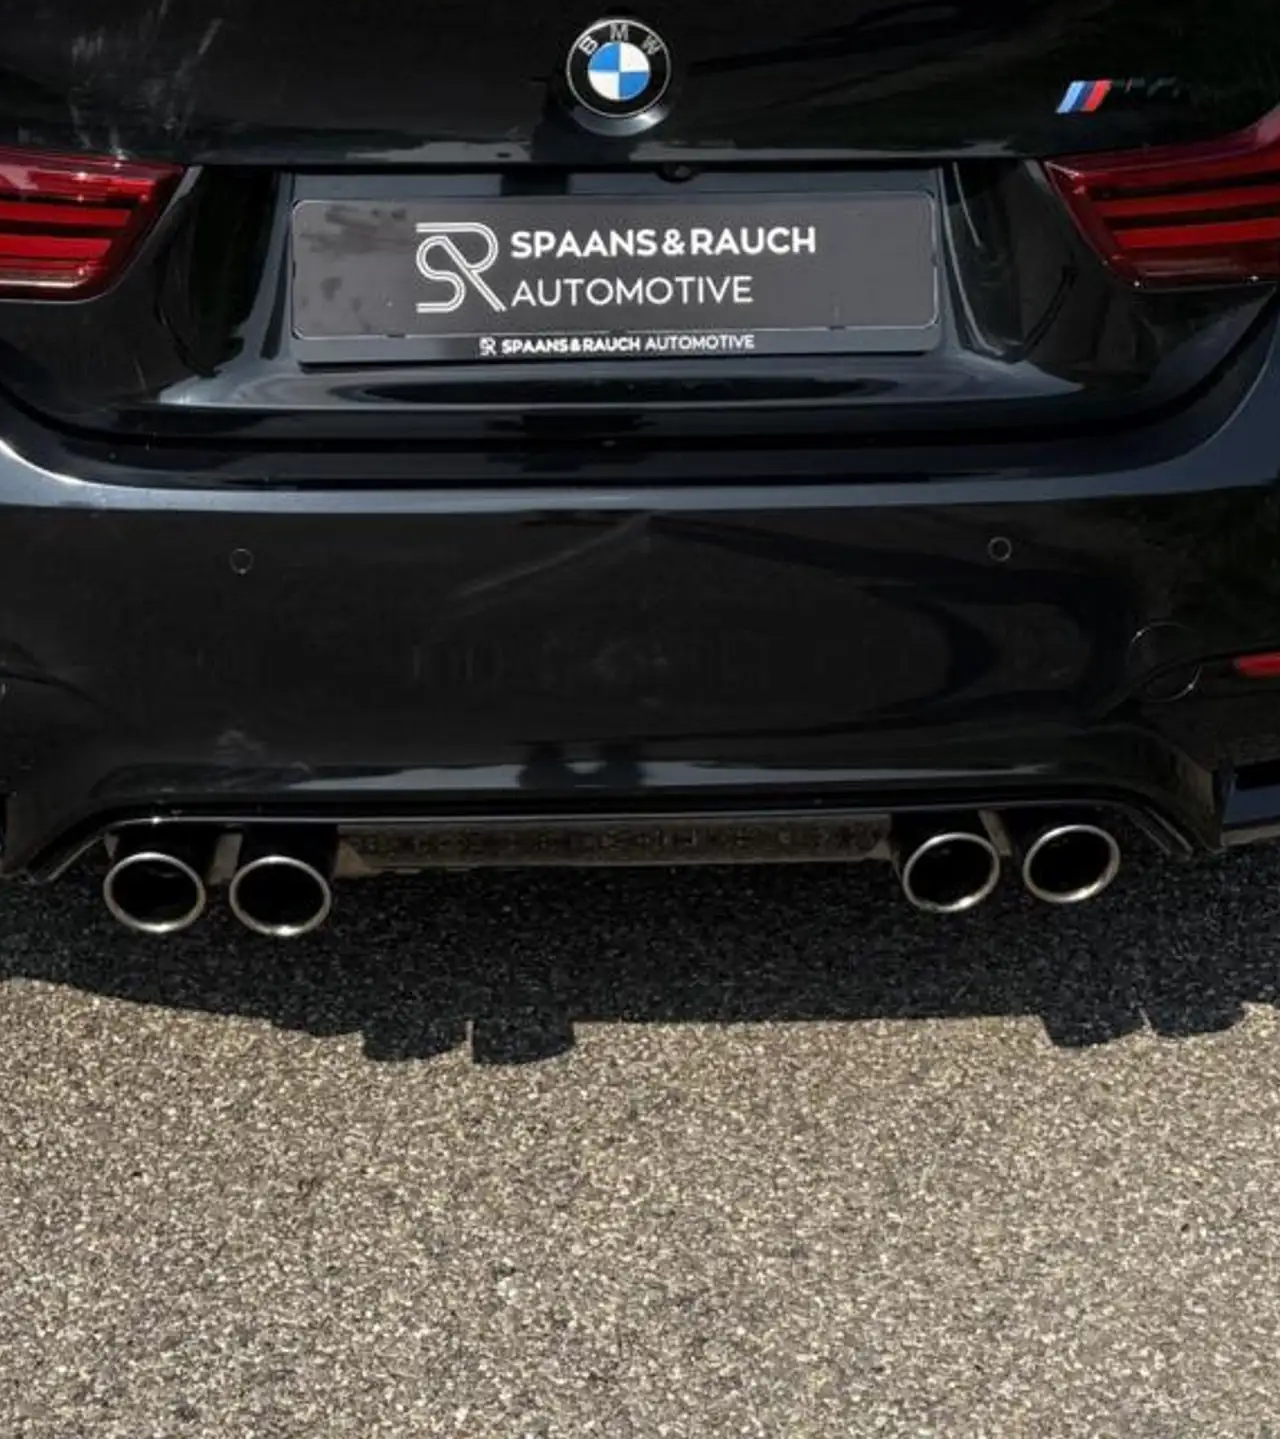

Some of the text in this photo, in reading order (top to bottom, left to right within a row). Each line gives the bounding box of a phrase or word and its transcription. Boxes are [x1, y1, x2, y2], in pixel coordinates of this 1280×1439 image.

[579, 22, 662, 56] BMW
[510, 226, 816, 258] SPAANS&RAUCH
[511, 275, 754, 308] AUTOMOTIVE
[644, 334, 755, 351] AUTOMOTIVE
